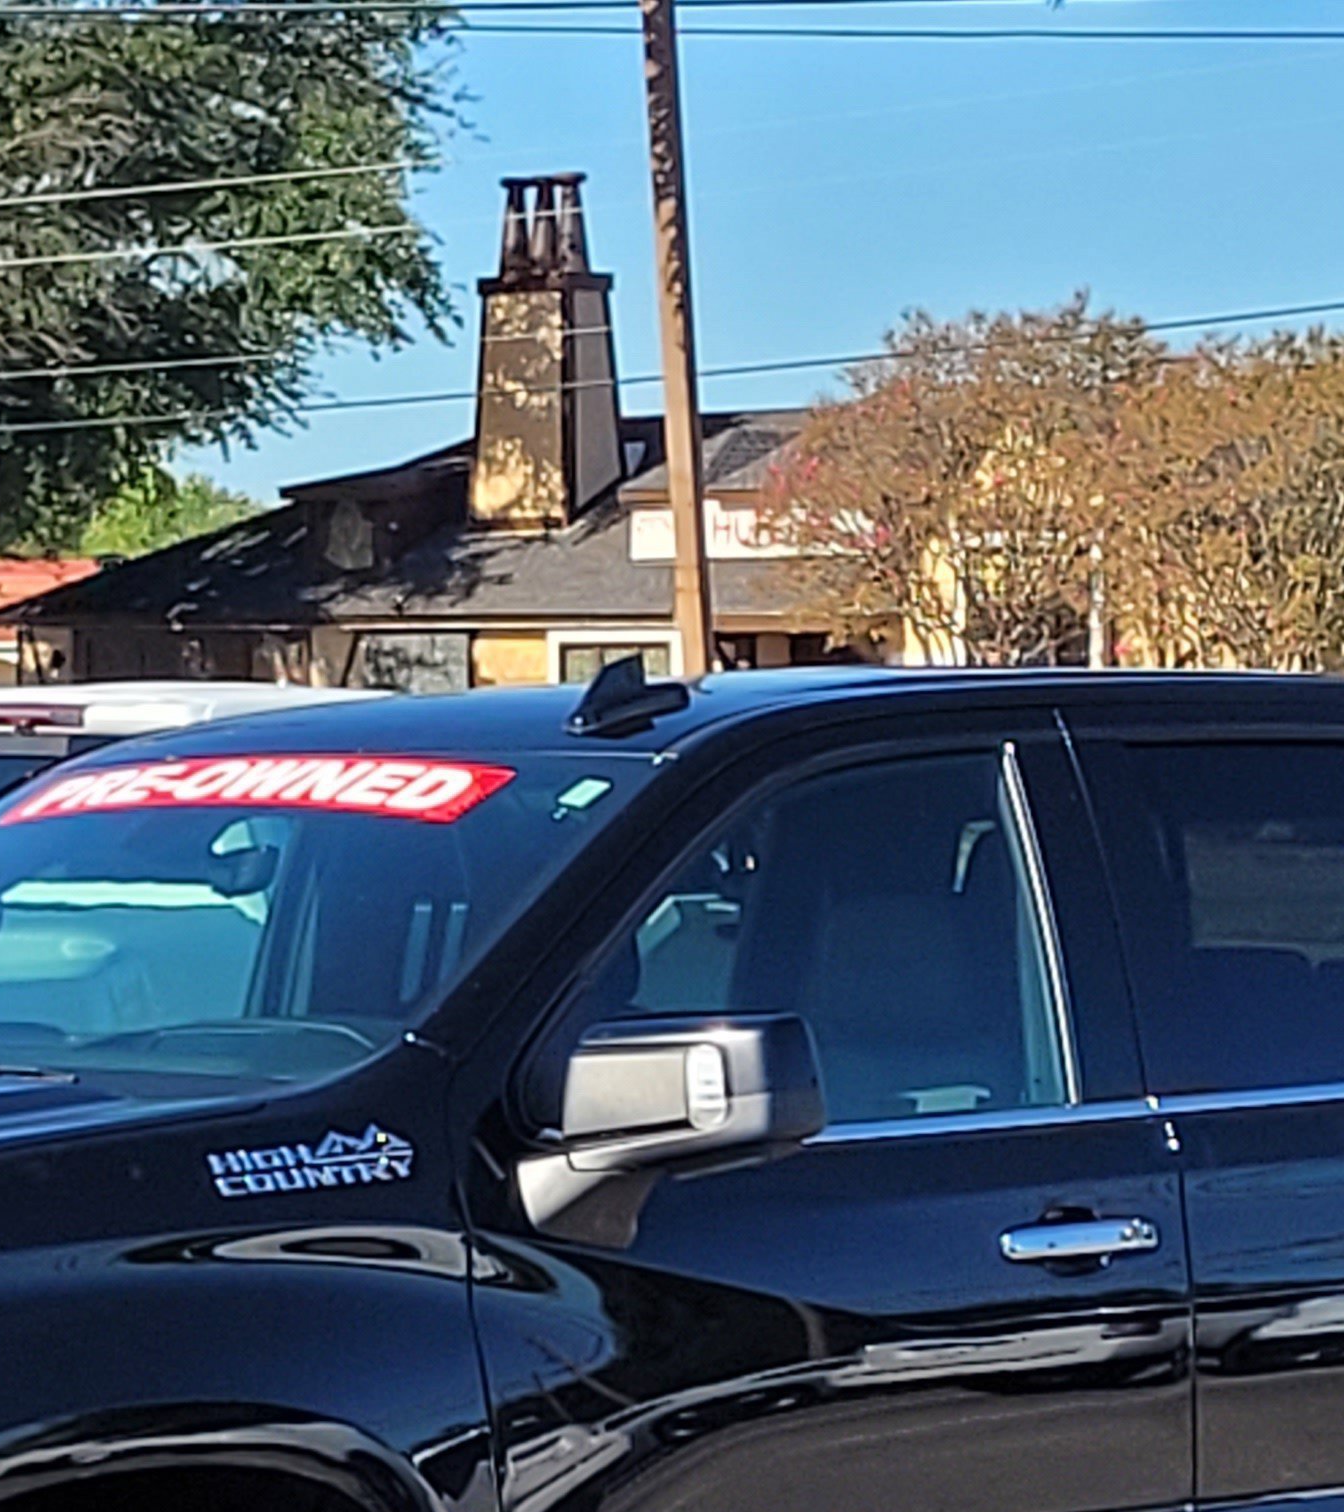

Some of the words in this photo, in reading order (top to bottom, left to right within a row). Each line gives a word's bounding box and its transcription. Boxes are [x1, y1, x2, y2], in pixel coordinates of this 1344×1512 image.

[20, 758, 473, 816] PRE-OWNED
[207, 1144, 316, 1175] HIGH
[215, 1156, 413, 1197] COUNTRY
